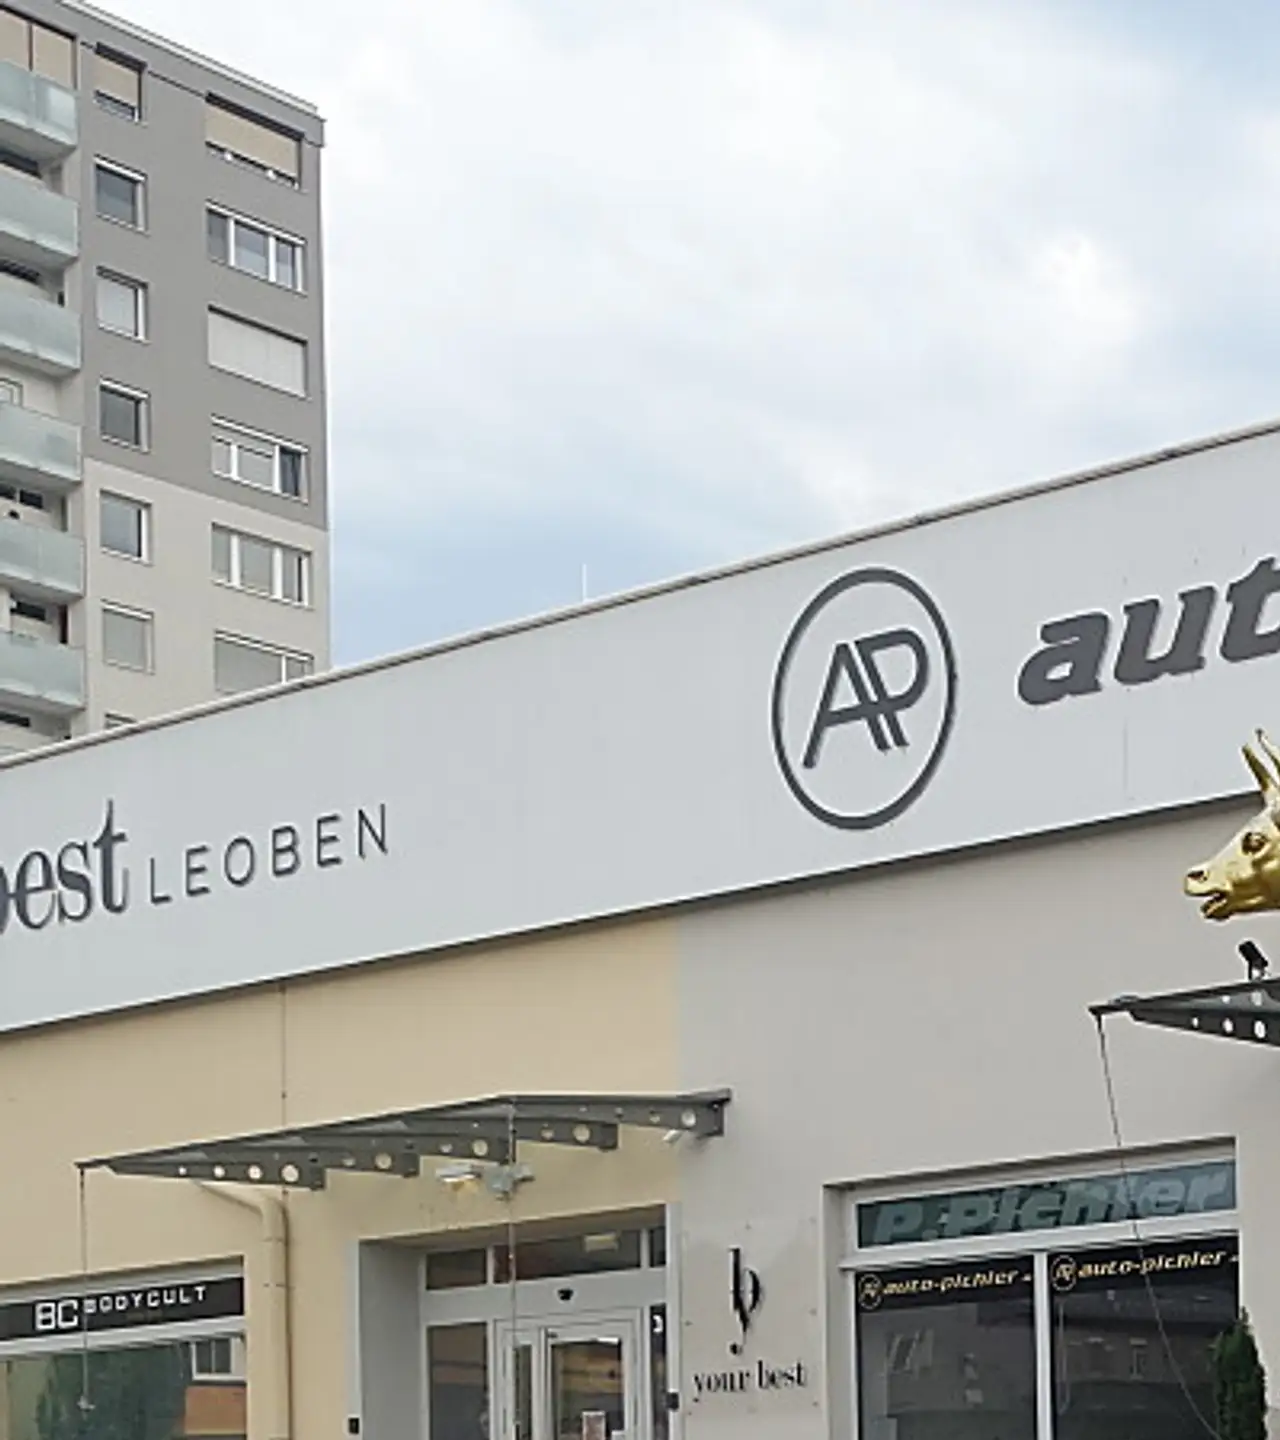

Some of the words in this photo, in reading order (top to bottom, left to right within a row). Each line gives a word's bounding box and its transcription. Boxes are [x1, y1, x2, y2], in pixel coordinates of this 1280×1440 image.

[803, 628, 929, 769] AP
[0, 799, 128, 935] est
[150, 803, 388, 905] LEOBEN
[35, 1300, 79, 1331] BC
[83, 1285, 207, 1314] BODYCULT
[693, 1371, 751, 1402] your
[757, 1360, 806, 1390] best
